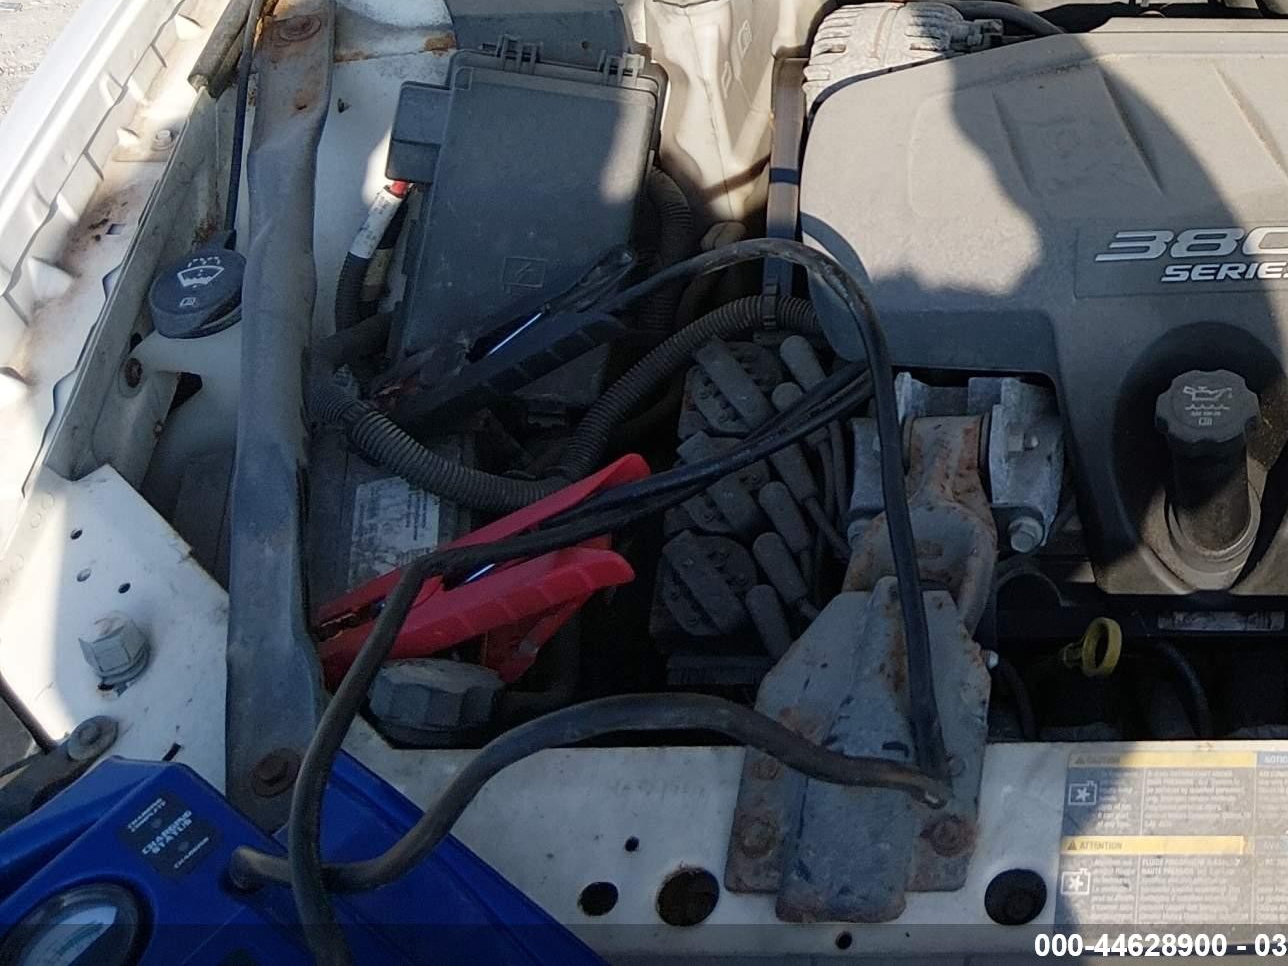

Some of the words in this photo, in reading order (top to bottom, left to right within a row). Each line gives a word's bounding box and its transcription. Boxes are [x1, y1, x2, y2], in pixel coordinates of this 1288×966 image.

[142, 810, 193, 855] CHARGING
[152, 818, 193, 854] STATUS
[1079, 841, 1122, 851] ATTENTION
